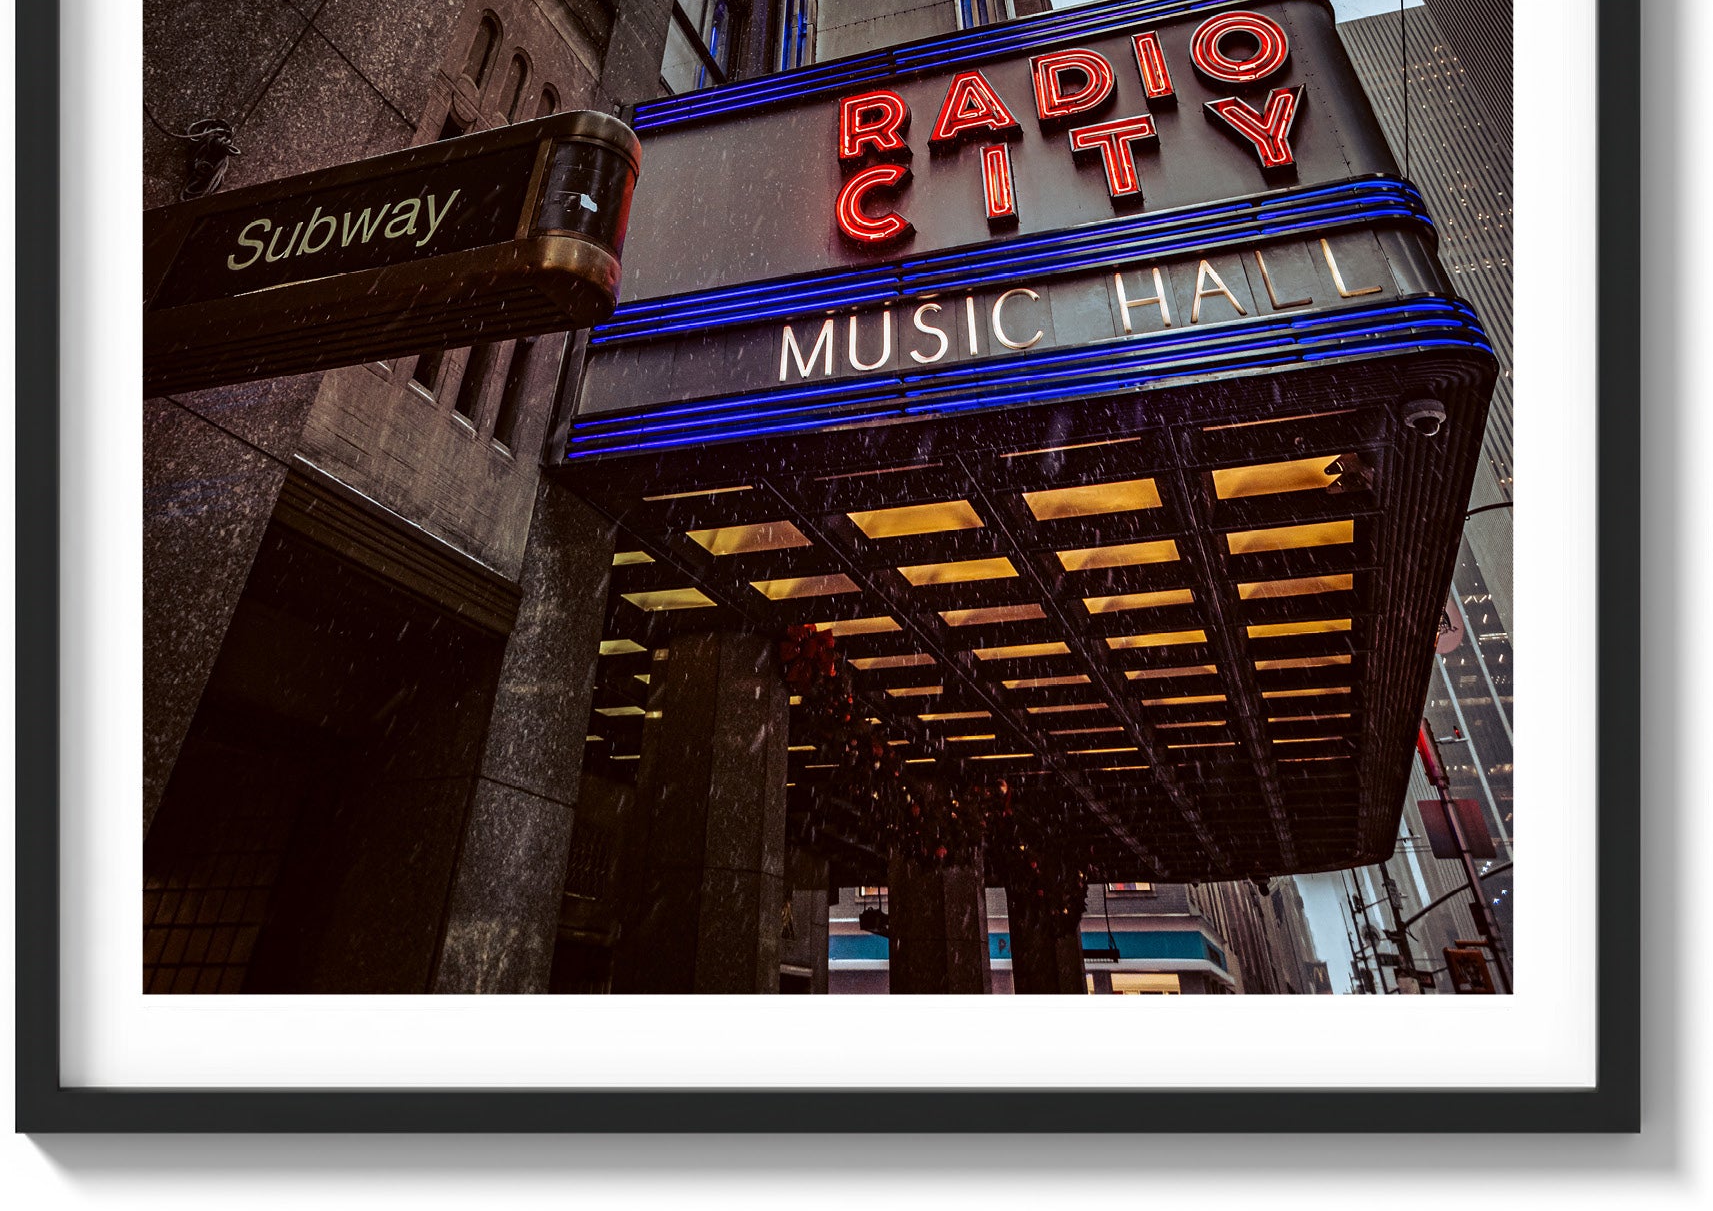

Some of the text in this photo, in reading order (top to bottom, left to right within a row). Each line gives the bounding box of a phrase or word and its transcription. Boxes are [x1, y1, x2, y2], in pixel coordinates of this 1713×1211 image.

[838, 10, 1290, 164] RADIO
[227, 189, 460, 271] Subway
[834, 84, 1305, 245] CITY
[778, 238, 1383, 382] MUSIC HALL
